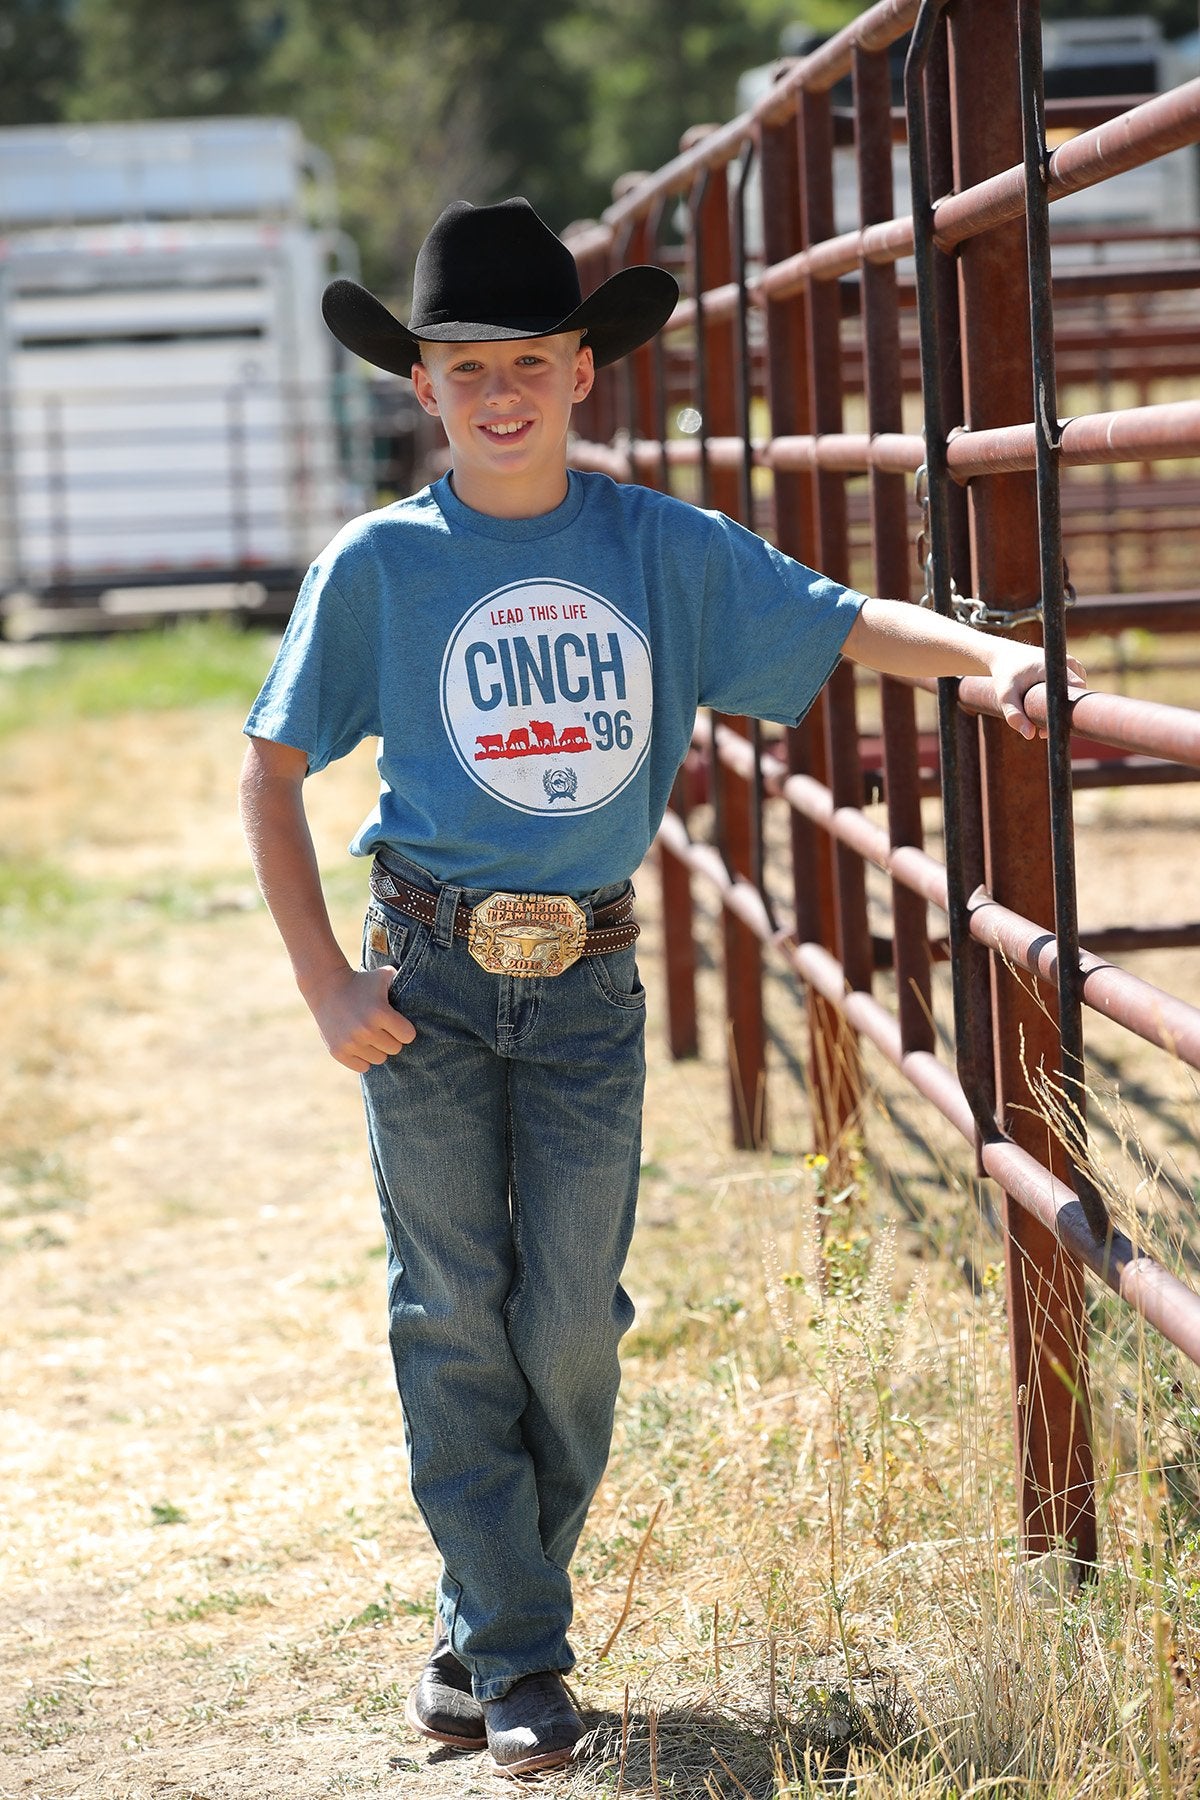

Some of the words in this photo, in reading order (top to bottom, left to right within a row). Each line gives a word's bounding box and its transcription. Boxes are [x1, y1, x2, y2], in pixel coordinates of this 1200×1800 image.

[490, 609, 524, 625] LEAD
[529, 605, 558, 621] THIS
[562, 604, 588, 619] LIFE
[464, 633, 626, 711] CINCH
[495, 901, 568, 913] CHAMPION
[487, 908, 526, 923] TEAM
[531, 913, 574, 927] ROPER
